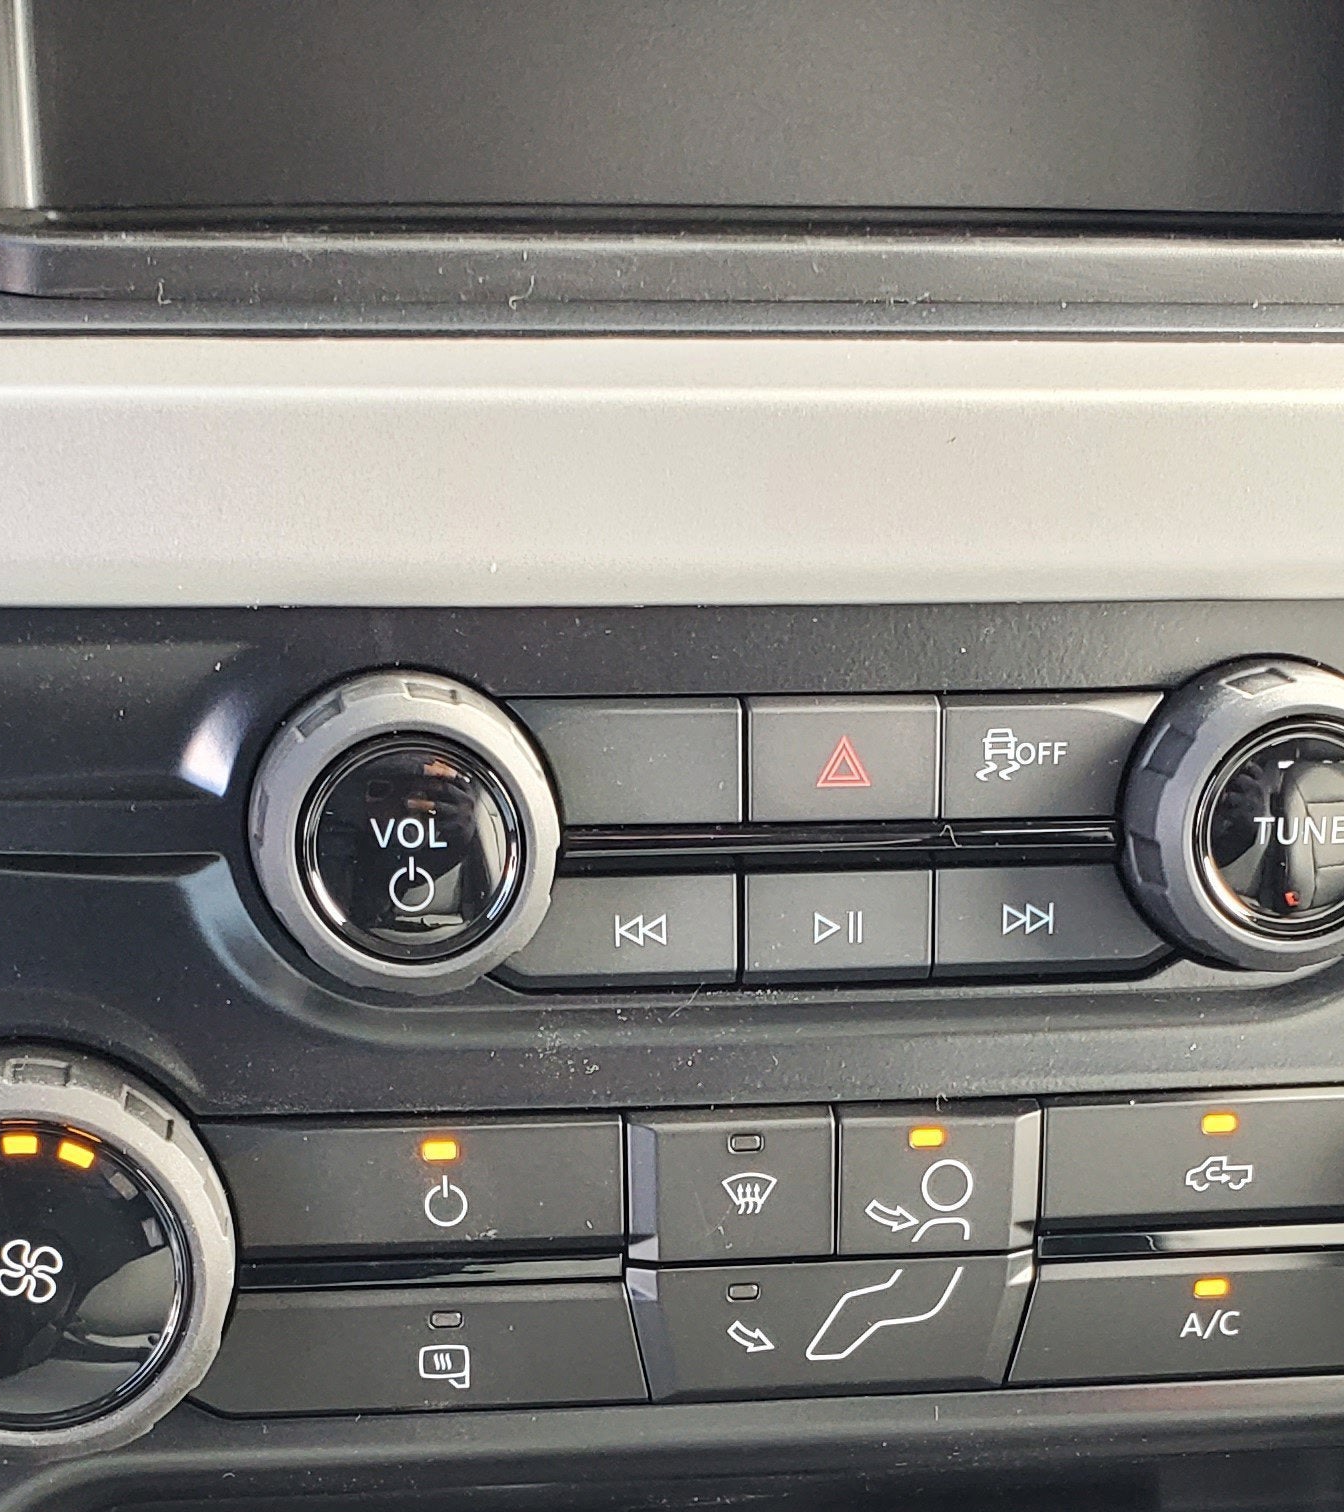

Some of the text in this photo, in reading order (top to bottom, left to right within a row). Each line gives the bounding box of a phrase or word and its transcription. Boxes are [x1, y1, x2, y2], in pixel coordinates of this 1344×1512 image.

[1017, 741, 1068, 766] OFF
[370, 817, 448, 849] VOL
[1179, 1309, 1240, 1340] A/C
